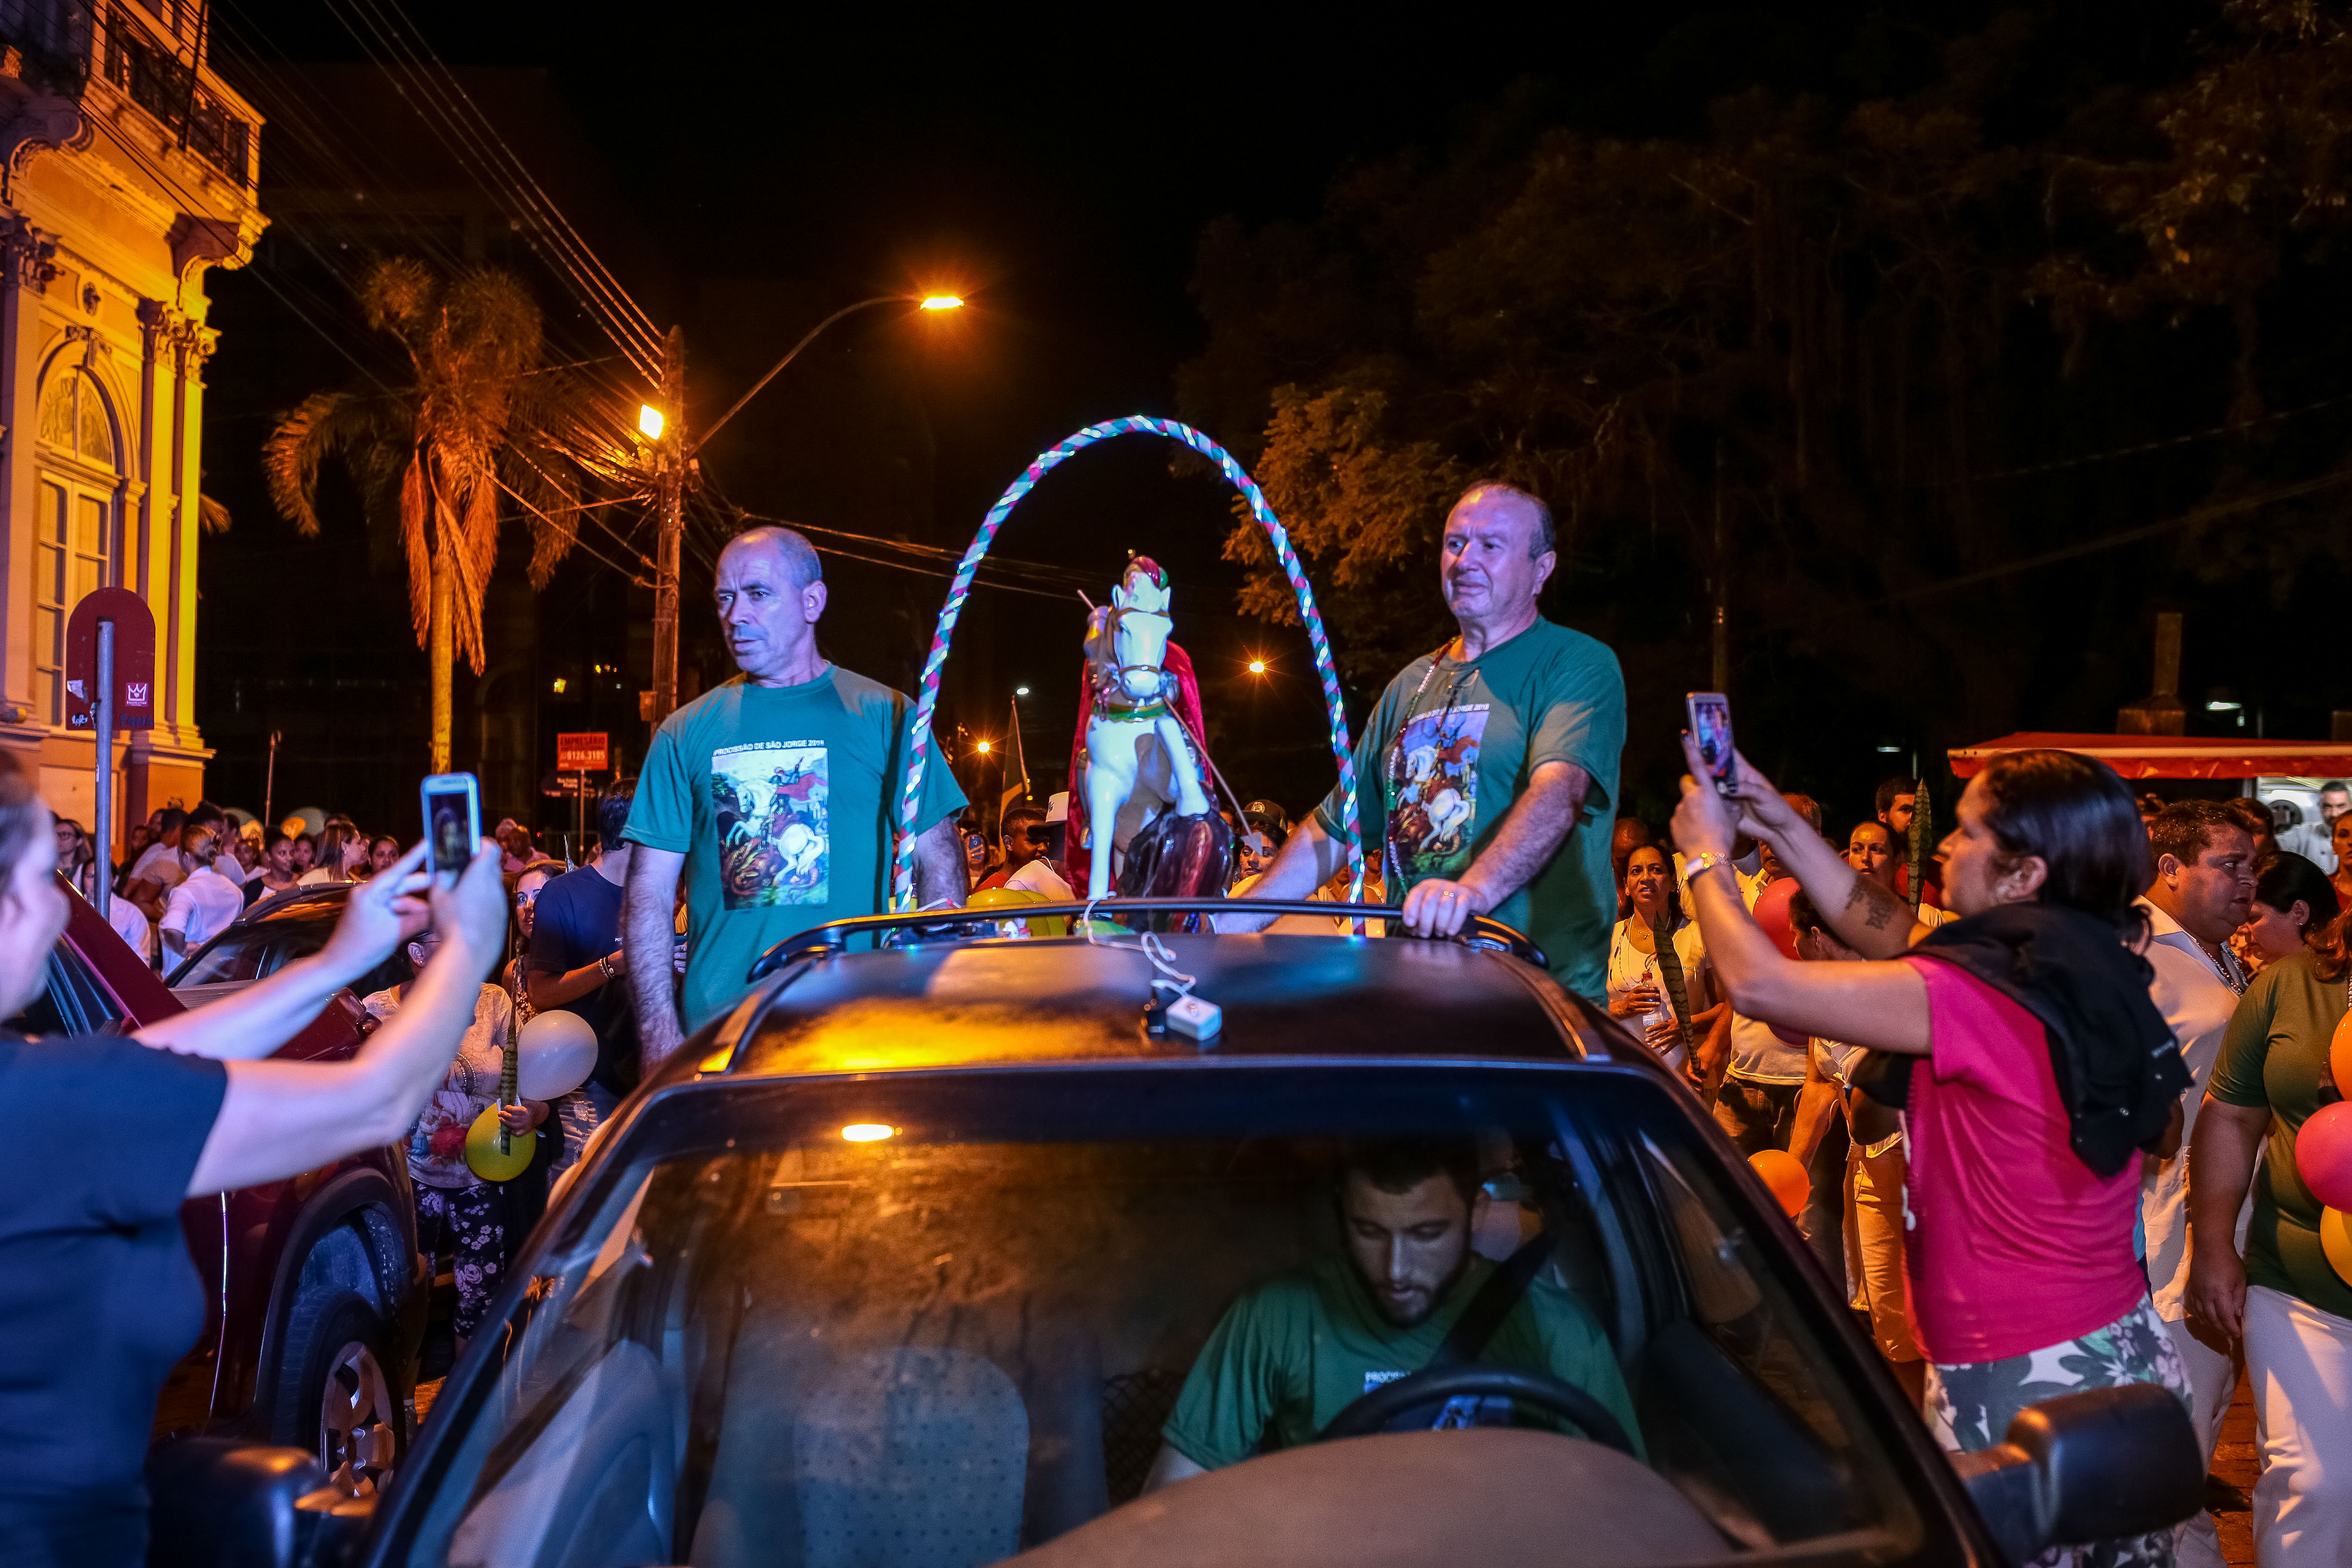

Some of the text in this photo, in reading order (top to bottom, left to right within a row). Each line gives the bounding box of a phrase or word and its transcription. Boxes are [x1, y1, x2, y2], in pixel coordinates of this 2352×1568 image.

[753, 741, 765, 750] DE
[765, 740, 782, 749] SÃO
[782, 739, 808, 748] JORGE
